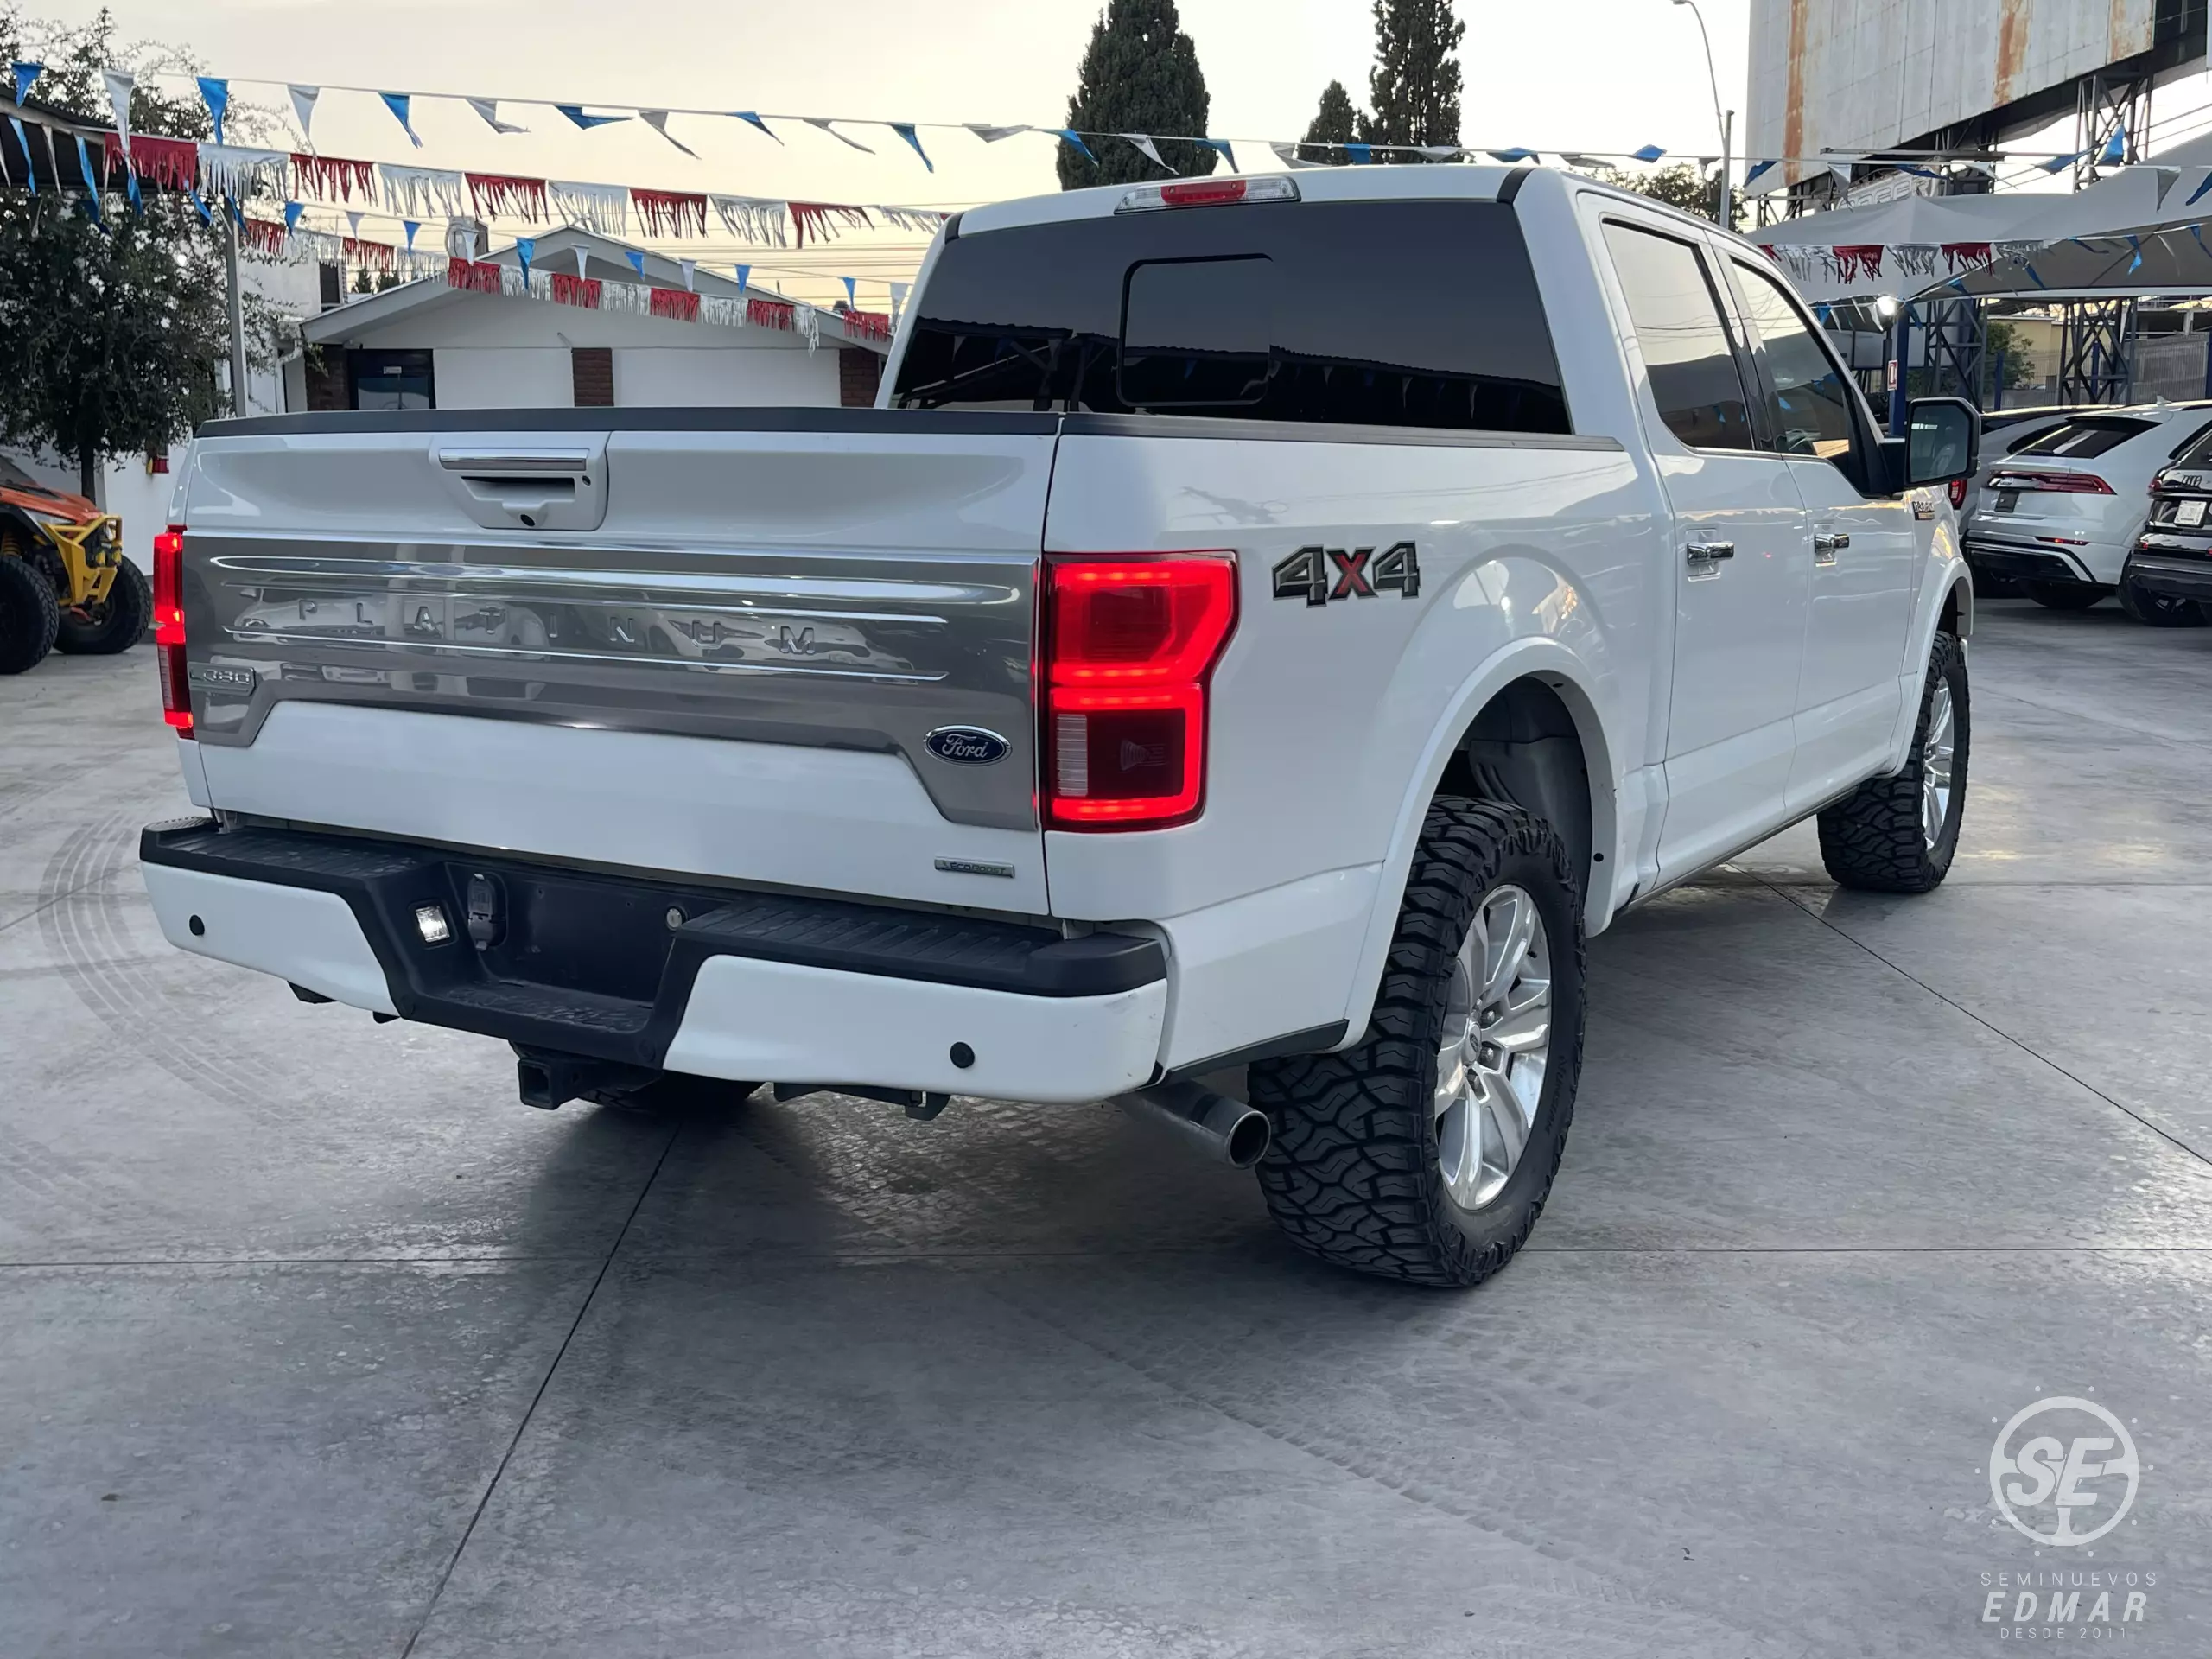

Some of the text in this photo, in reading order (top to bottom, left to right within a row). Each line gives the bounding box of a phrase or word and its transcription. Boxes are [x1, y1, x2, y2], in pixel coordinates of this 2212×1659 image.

[1272, 540, 1421, 608] 4X4
[298, 599, 815, 655] PLATINUM
[942, 734, 988, 758] Ford
[950, 861, 1007, 874] ECOBOOST
